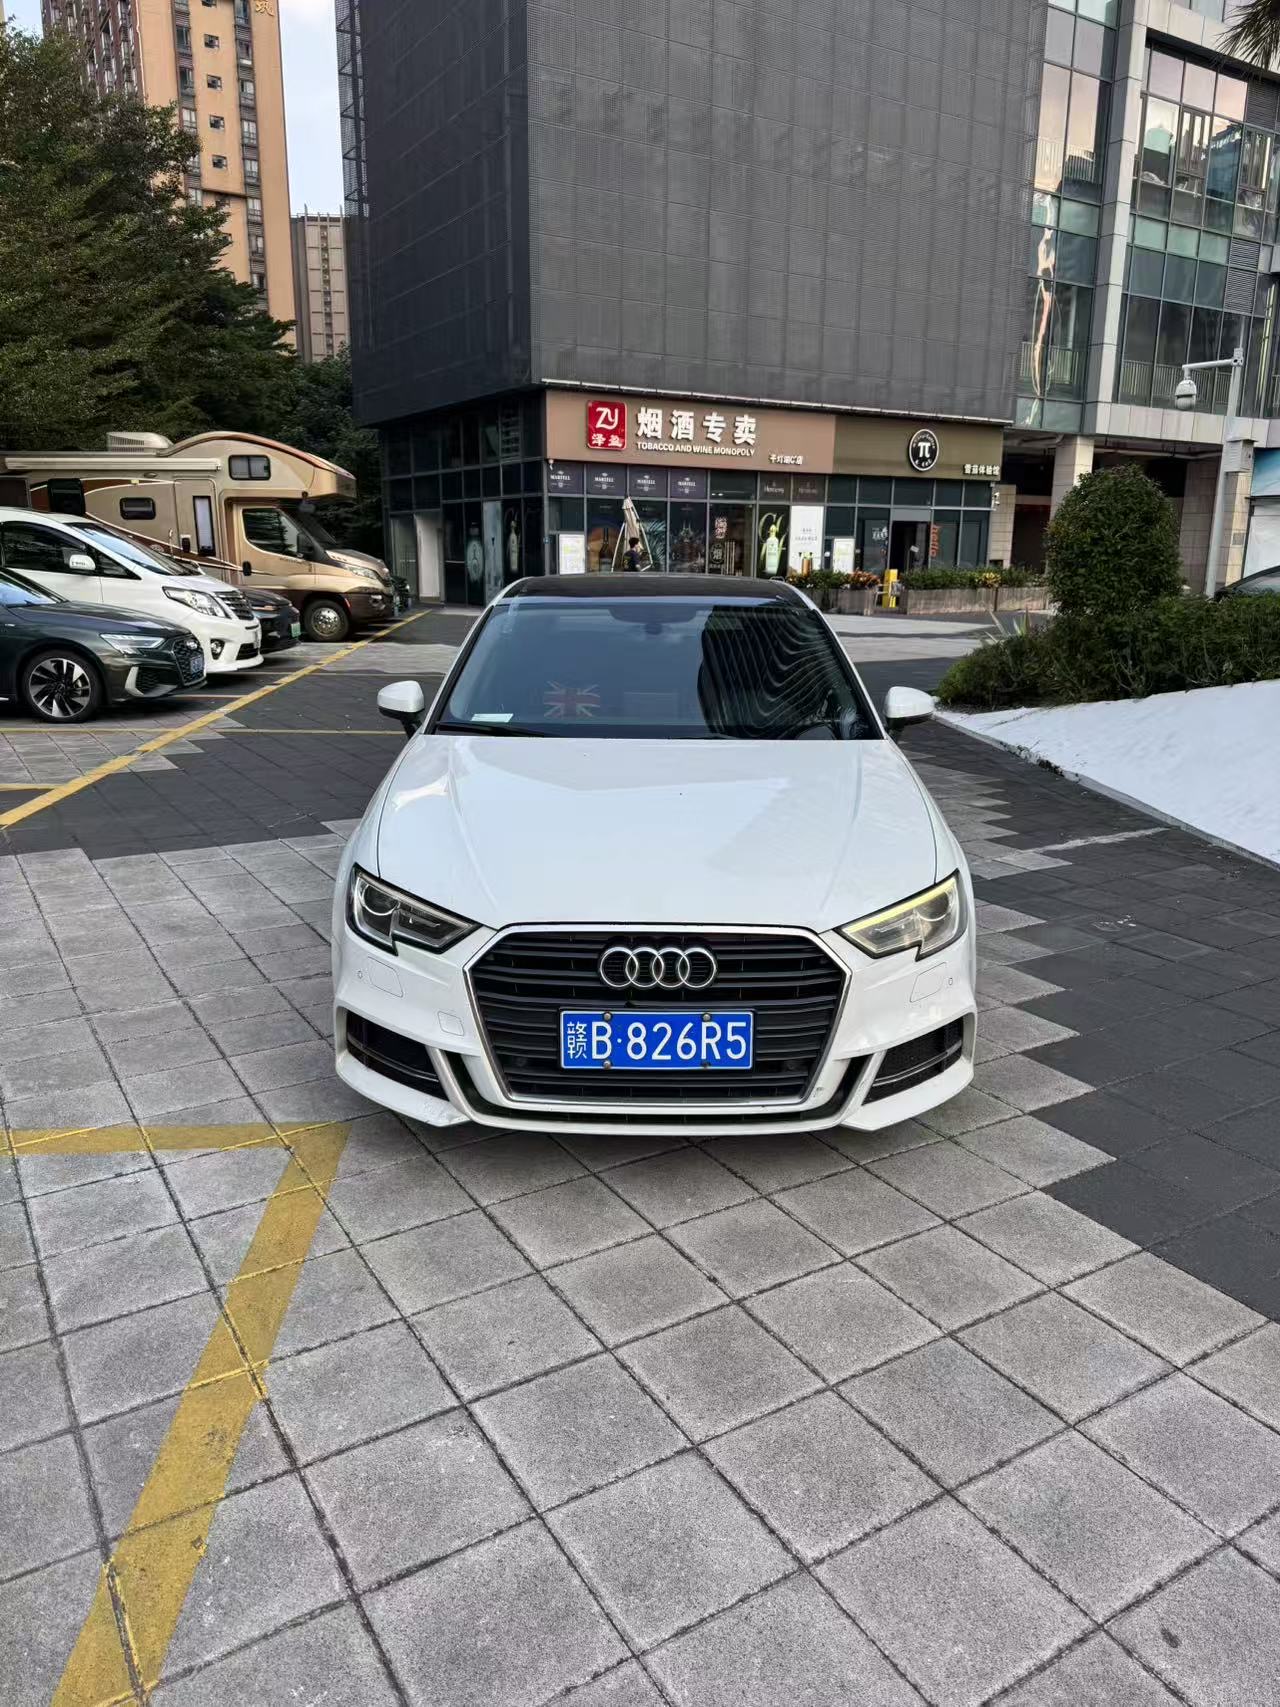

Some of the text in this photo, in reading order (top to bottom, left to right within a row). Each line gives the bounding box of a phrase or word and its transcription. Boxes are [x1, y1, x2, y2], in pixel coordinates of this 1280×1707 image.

[637, 407, 757, 446] 烟酒专卖
[636, 442, 755, 456] TOBACCO AND WINE MONOPOLY
[566, 1021, 747, 1060] 赣B·826R5
